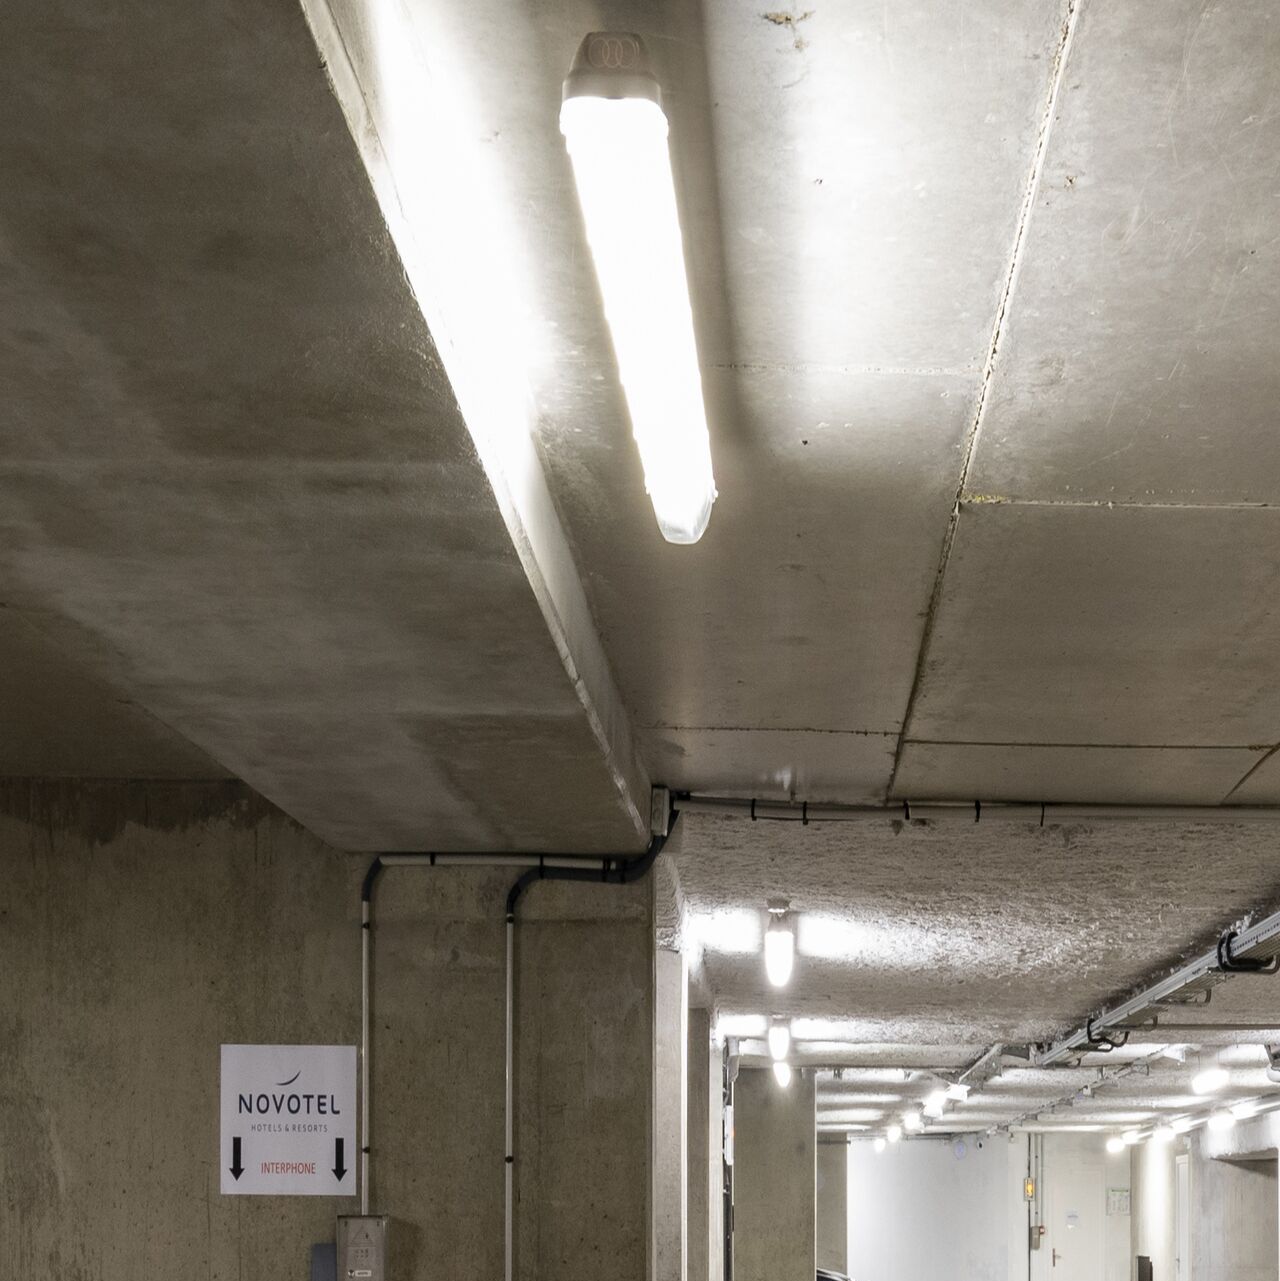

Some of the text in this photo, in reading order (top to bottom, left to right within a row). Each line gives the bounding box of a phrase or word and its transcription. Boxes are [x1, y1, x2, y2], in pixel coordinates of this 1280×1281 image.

[238, 1093, 341, 1115] NOVOTEL
[251, 1123, 328, 1133] HOTELS & RESORTS
[261, 1162, 316, 1175] INTERPHONE
